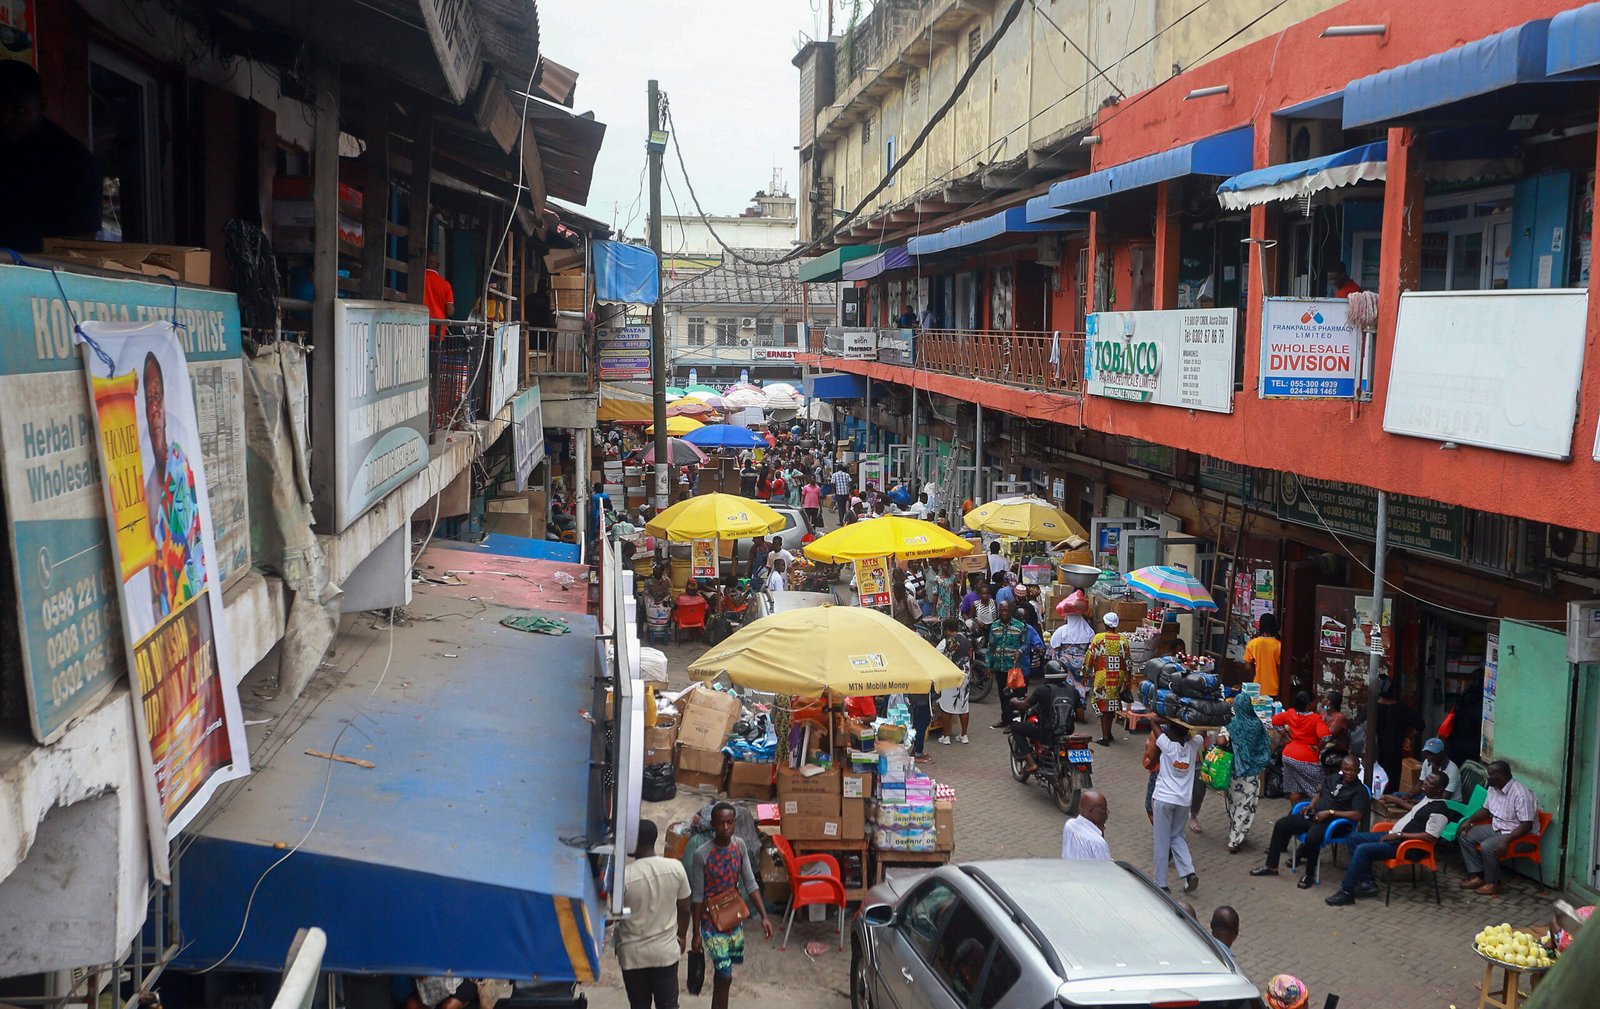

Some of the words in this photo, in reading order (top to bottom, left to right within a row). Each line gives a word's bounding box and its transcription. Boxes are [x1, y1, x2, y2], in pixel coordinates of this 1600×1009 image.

[1272, 324, 1317, 332] FRANKPAULS
[1318, 325, 1355, 333] PHARMACY
[1271, 343, 1350, 354] WHOLESALE
[1094, 340, 1158, 375] TOBINCO
[1270, 355, 1350, 371] DIVISION
[1290, 380, 1319, 388] 055-300
[23, 413, 76, 459] Herbal
[105, 424, 137, 461] HOME
[109, 465, 144, 513] CALL
[1407, 507, 1448, 525] HELPLINES
[1430, 526, 1453, 542] RETAIL
[862, 558, 878, 566] MTN
[46, 626, 79, 669] 0208
[848, 682, 863, 691] MTN
[866, 681, 887, 690] Mobile
[888, 681, 910, 691] Money
